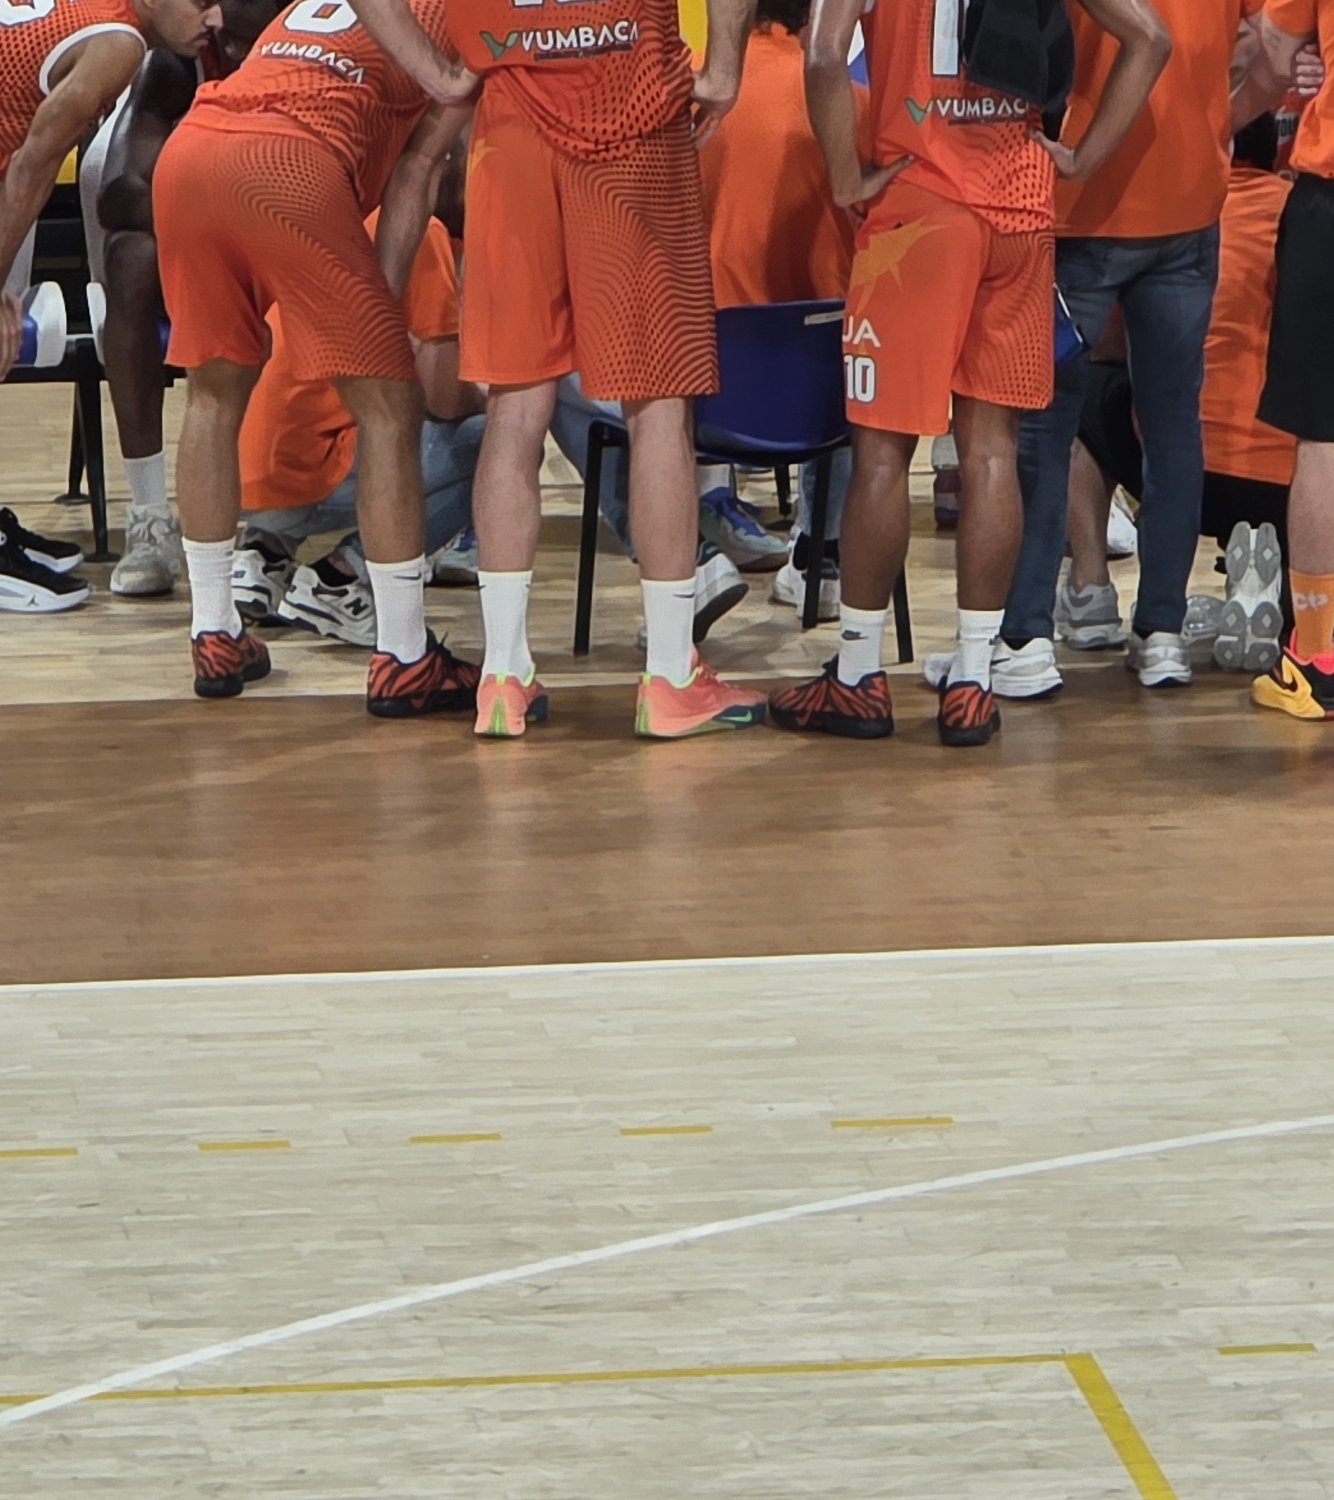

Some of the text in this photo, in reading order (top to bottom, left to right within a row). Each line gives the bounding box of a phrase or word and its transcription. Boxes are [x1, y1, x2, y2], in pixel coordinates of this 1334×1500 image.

[520, 20, 640, 53] VUMBACA
[936, 97, 1030, 118] VUMBAC
[843, 355, 876, 404] 10
